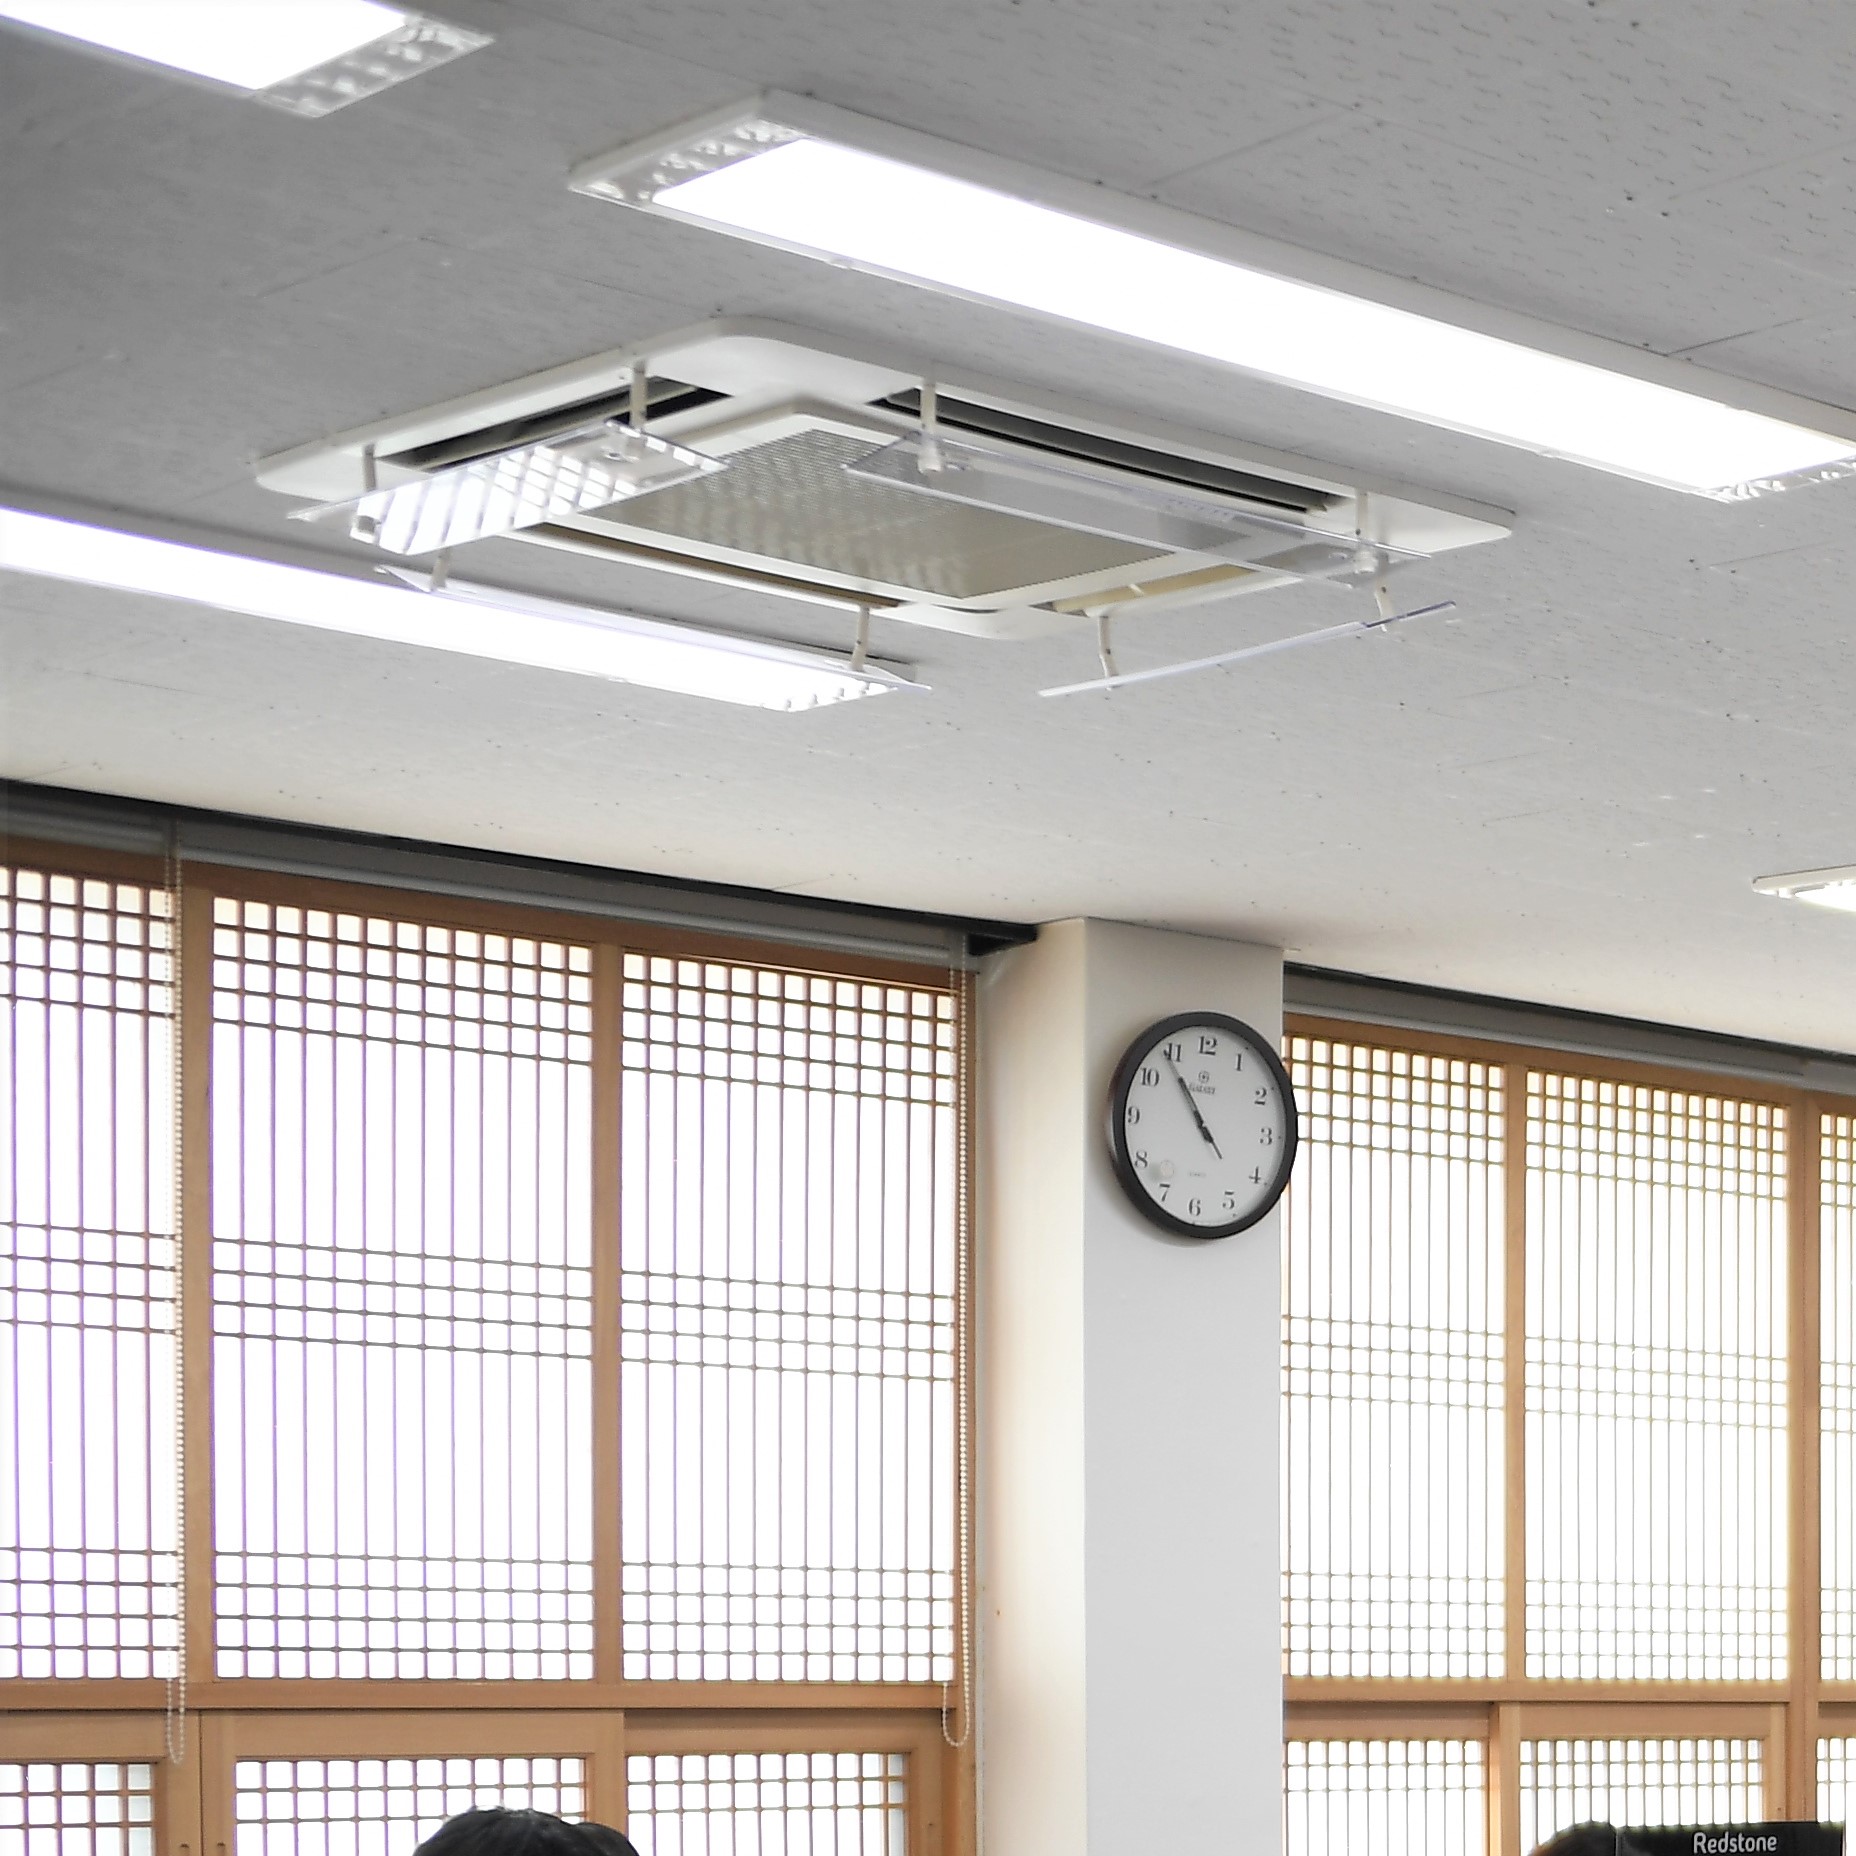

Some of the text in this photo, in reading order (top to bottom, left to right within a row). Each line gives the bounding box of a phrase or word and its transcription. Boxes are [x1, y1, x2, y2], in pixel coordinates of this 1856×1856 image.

[1163, 1042, 1182, 1063] 11
[1199, 1035, 1218, 1056] 12
[1236, 1053, 1247, 1072] 1
[1139, 1067, 1160, 1087] 10
[1255, 1088, 1267, 1105] 2
[1128, 1106, 1140, 1124] 9
[1260, 1128, 1272, 1145] 3
[1134, 1151, 1148, 1169] 8
[1249, 1166, 1261, 1184] 4
[1159, 1184, 1170, 1202] 7
[1223, 1191, 1234, 1209] 5
[1189, 1199, 1200, 1216] 6
[1694, 1831, 1777, 1853] Redstone
